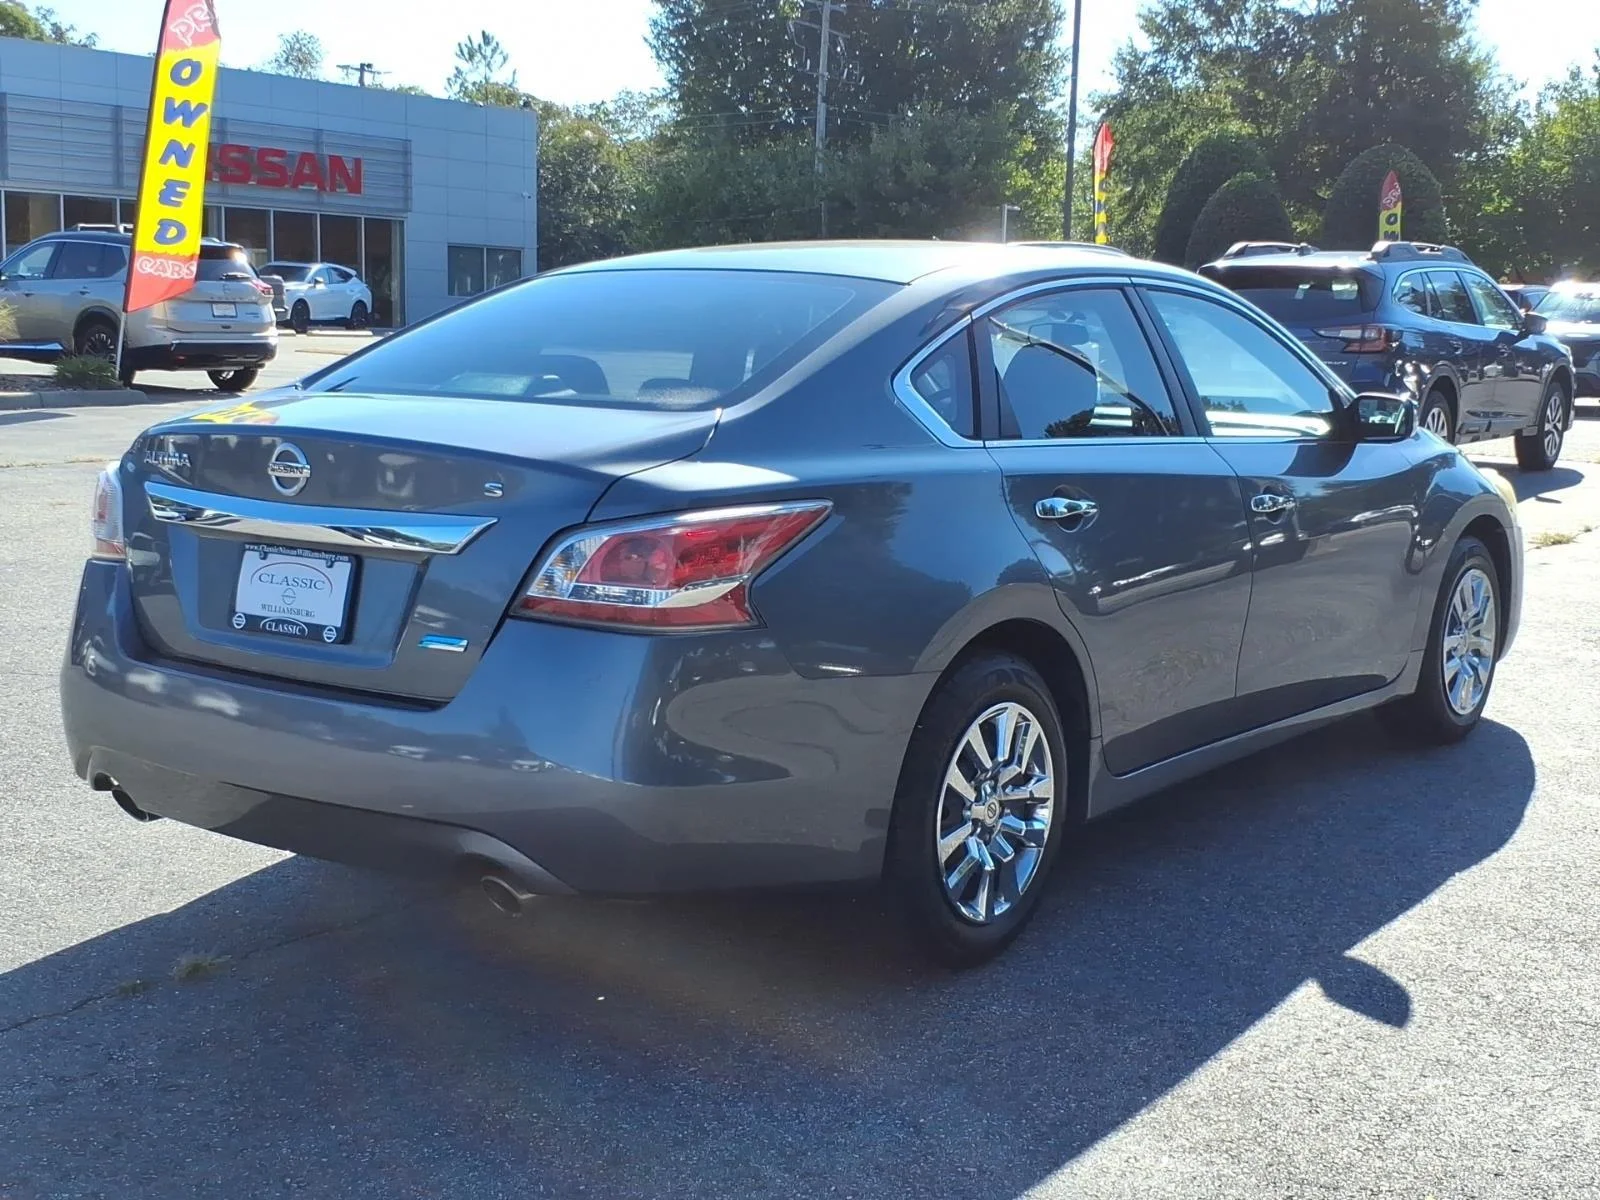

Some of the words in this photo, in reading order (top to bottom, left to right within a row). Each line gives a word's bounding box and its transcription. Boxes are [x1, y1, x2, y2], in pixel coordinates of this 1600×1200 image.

[153, 58, 208, 245] OWNED
[136, 256, 196, 280] CARS
[268, 463, 304, 475] NISSAN
[483, 482, 504, 497] S
[258, 572, 326, 591] CLASSIC
[261, 603, 316, 618] WILLIAMSBURG
[265, 620, 303, 636] CLASSIC
